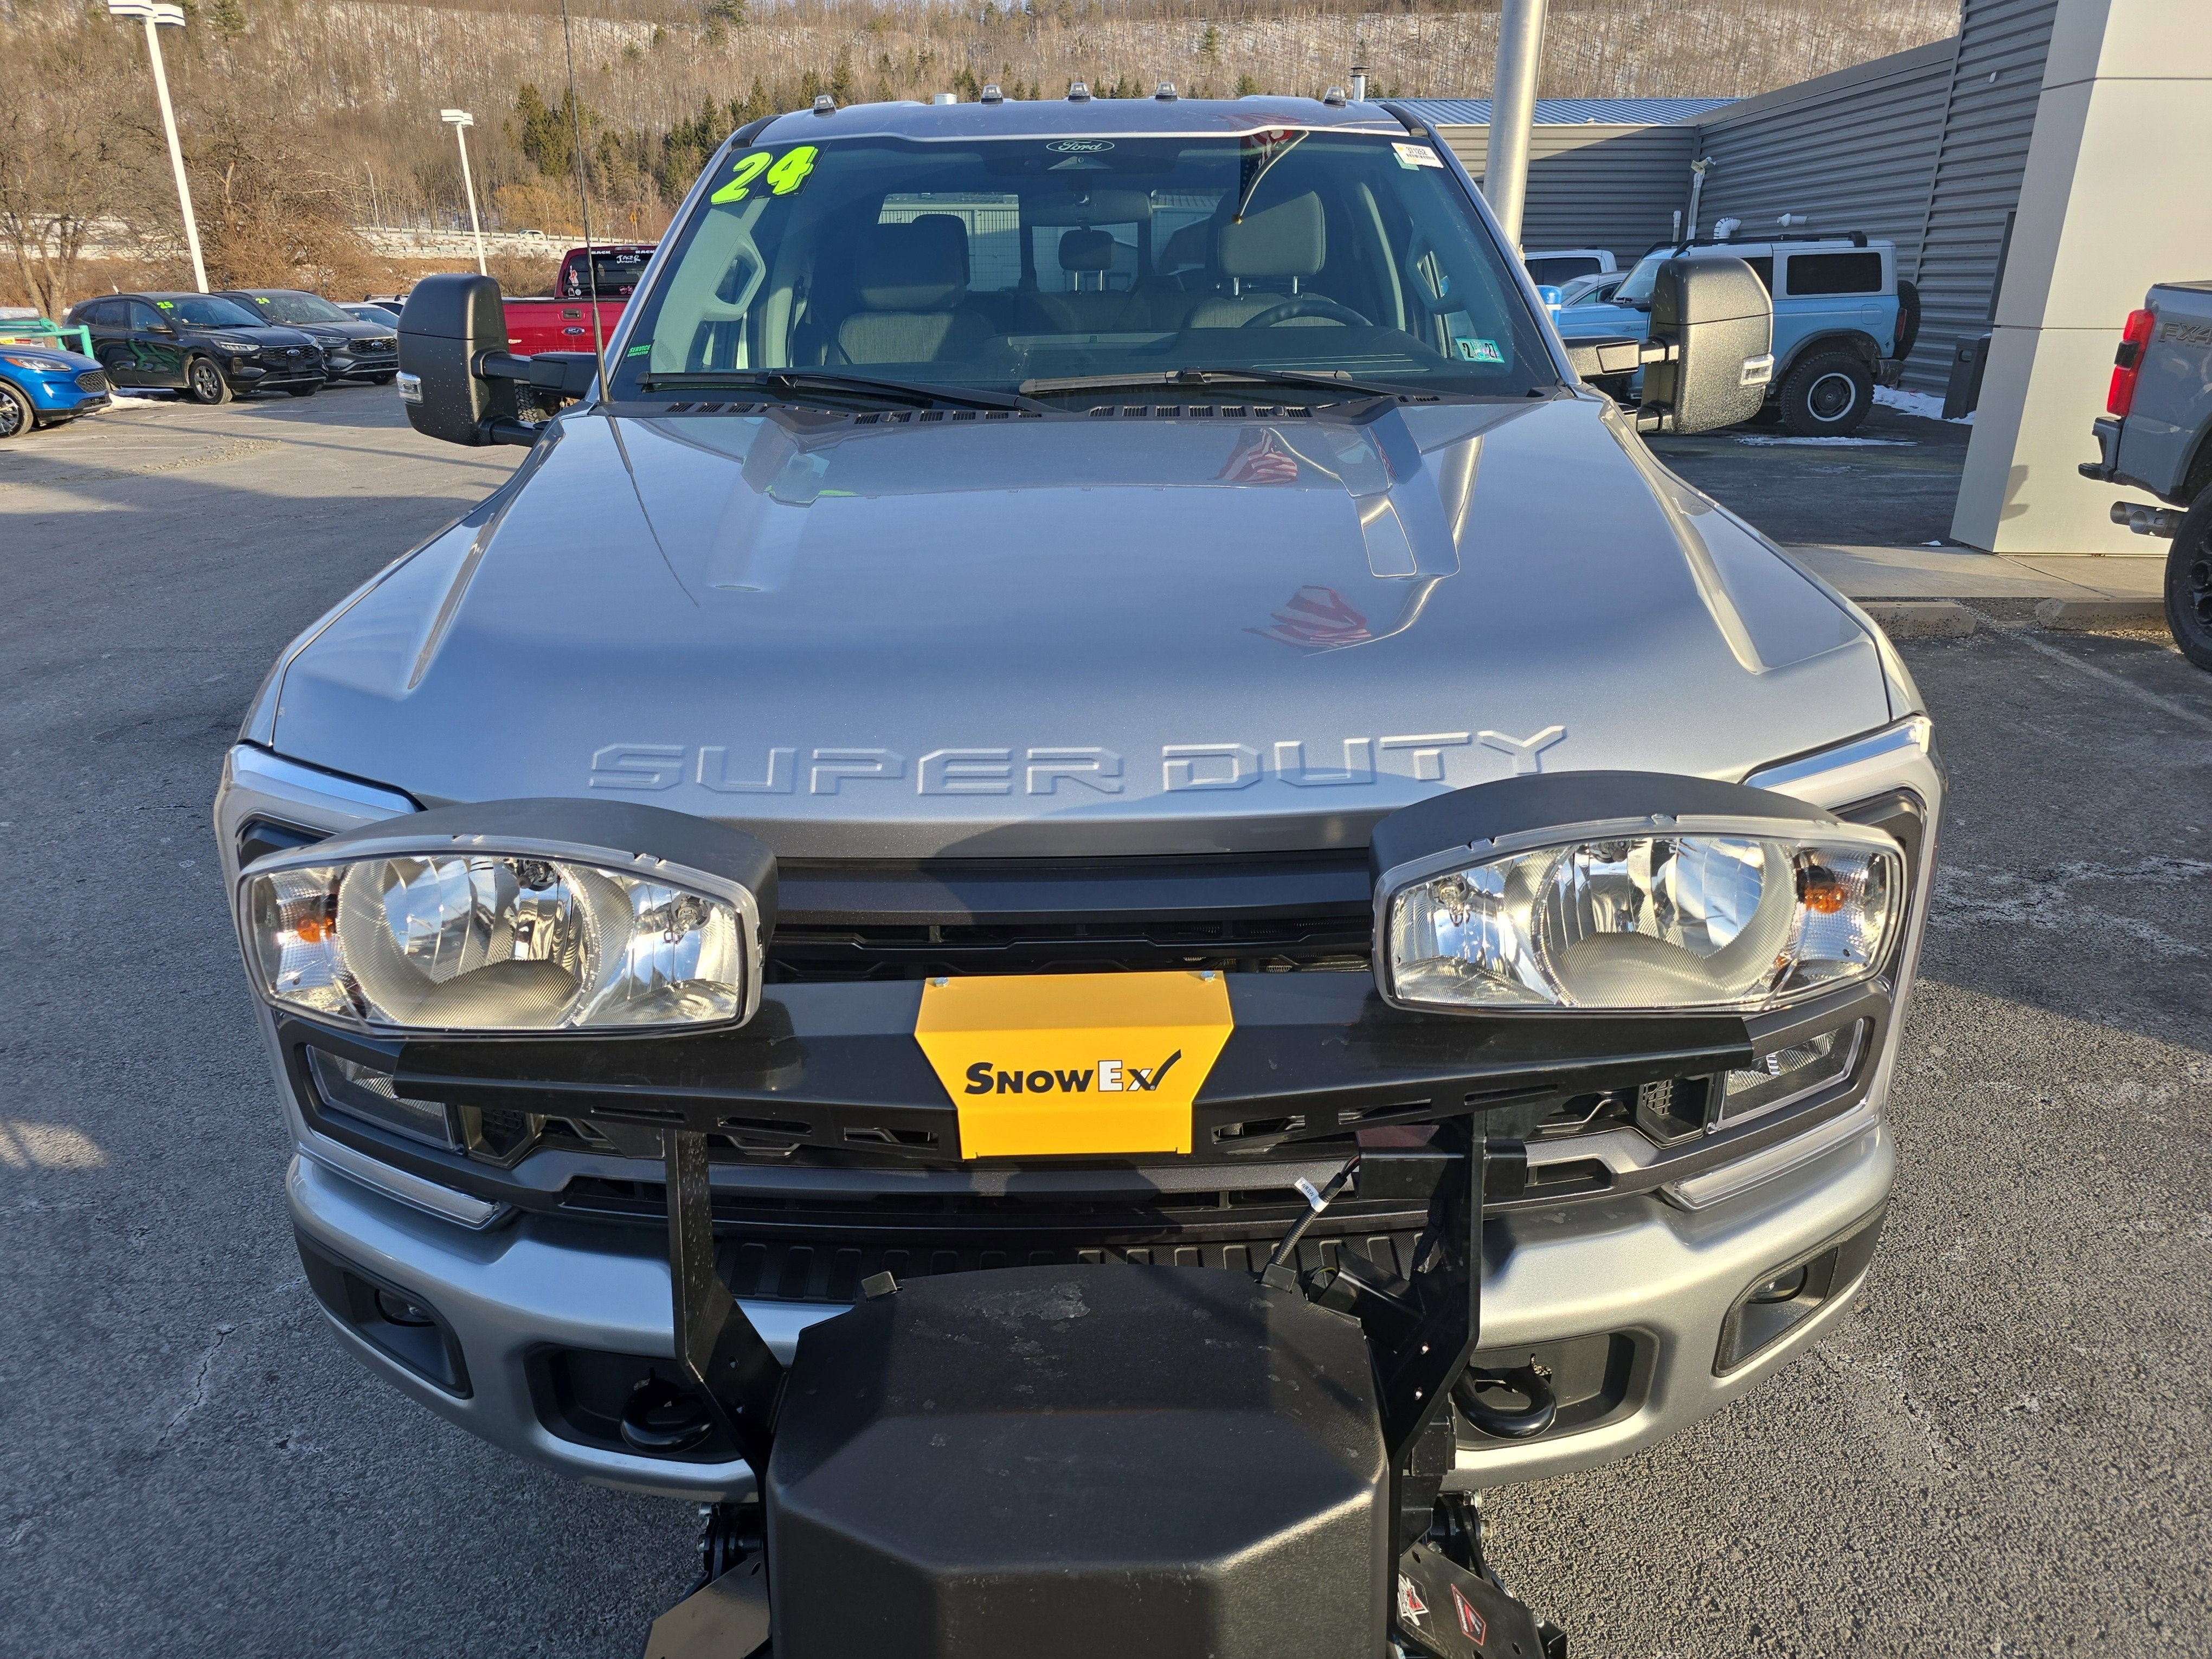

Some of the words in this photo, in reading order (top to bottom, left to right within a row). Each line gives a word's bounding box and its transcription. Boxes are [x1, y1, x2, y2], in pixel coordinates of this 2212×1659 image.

[1057, 140, 1103, 151] Ford
[711, 146, 819, 205] 24
[629, 344, 651, 353] SERVICE
[1462, 342, 1474, 358] 2
[1484, 342, 1497, 358] 27
[589, 742, 1124, 795] SUPER
[1162, 725, 1568, 792] DUTY
